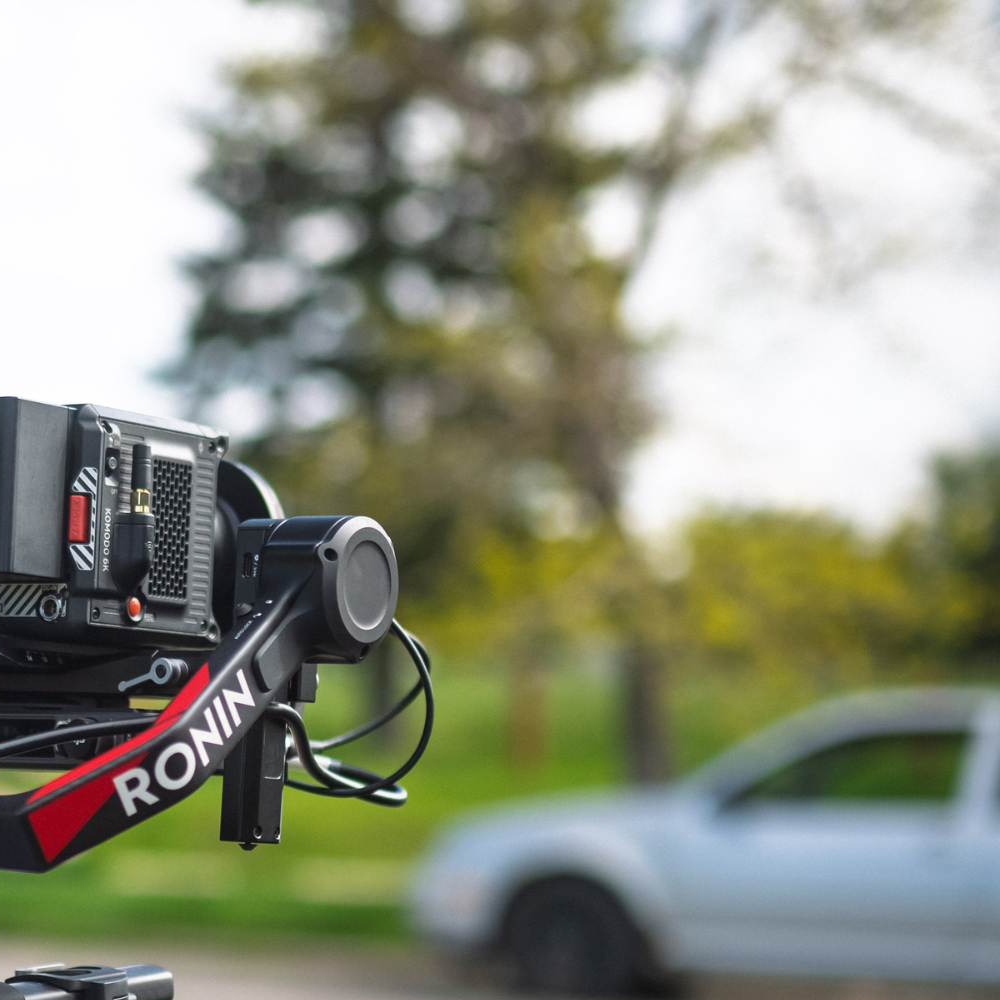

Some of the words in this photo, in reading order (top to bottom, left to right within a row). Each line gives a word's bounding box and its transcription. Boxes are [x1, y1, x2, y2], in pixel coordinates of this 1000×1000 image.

[103, 508, 112, 555] KOMODO
[102, 559, 109, 572] 6K
[113, 669, 255, 817] RONIN
